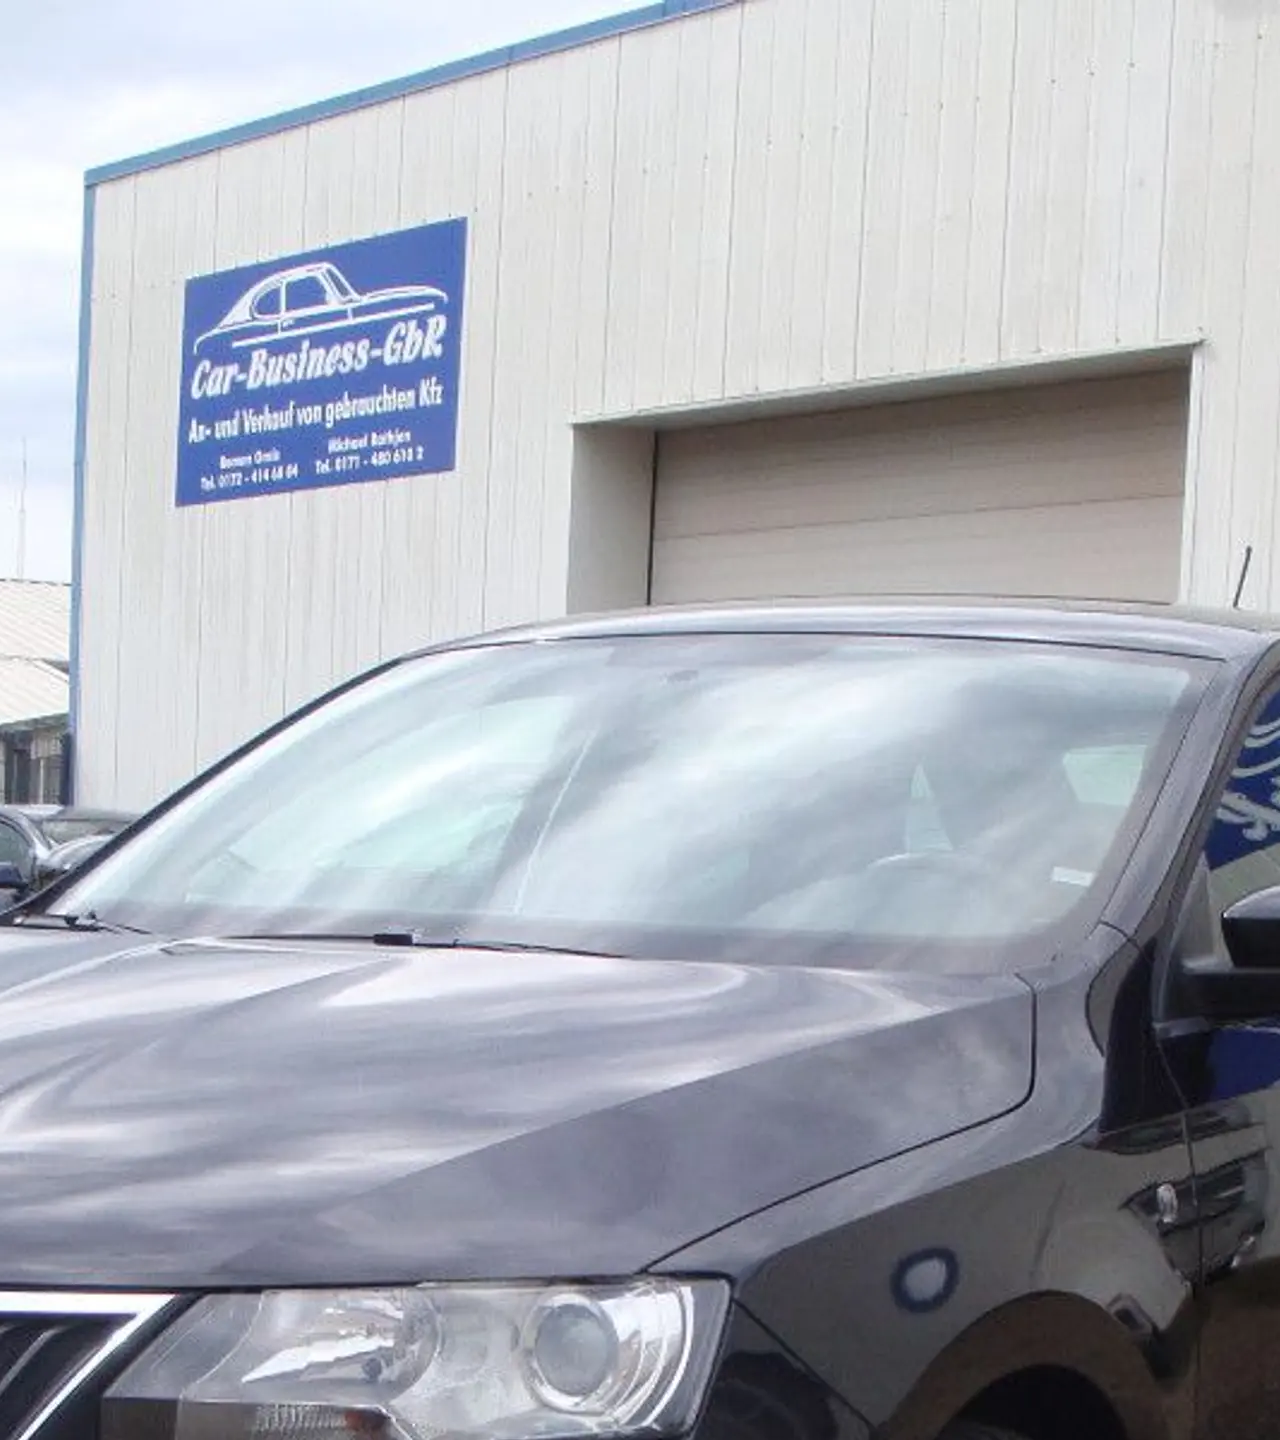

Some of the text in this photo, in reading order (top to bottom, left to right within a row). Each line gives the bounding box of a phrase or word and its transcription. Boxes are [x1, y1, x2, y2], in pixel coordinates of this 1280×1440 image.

[191, 314, 448, 399] Car-Business-GbR
[188, 376, 444, 444] An- und Verkauf von gebrauchten Kfz
